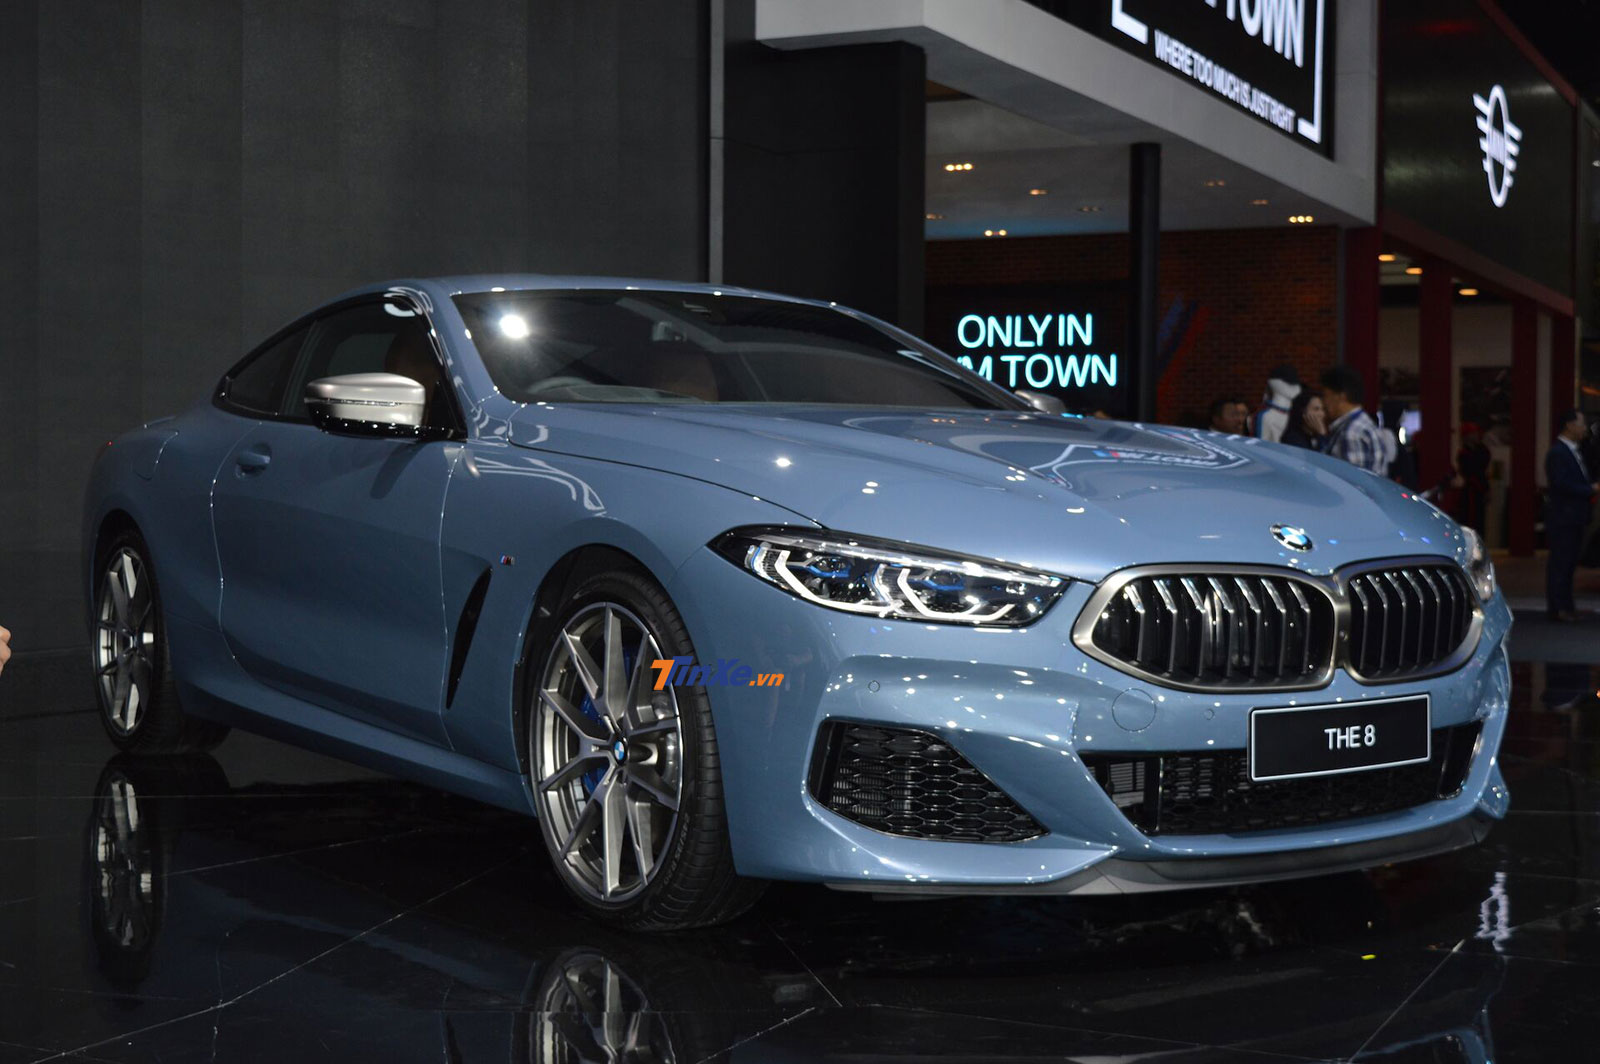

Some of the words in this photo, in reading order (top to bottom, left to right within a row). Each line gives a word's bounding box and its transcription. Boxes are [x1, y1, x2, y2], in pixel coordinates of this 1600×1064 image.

[1225, 0, 1305, 68] OWN
[1154, 29, 1193, 77] WHERE
[1193, 50, 1214, 87] TOO
[1213, 64, 1240, 104] MUCH
[1240, 80, 1250, 109] IS
[1250, 87, 1271, 121] JUST
[1269, 98, 1296, 134] RIGHT
[957, 314, 1052, 348] ONLY
[1058, 313, 1093, 347] IN
[1000, 353, 1117, 388] TOWN
[1324, 725, 1361, 750] THE
[1364, 724, 1376, 747] 8
